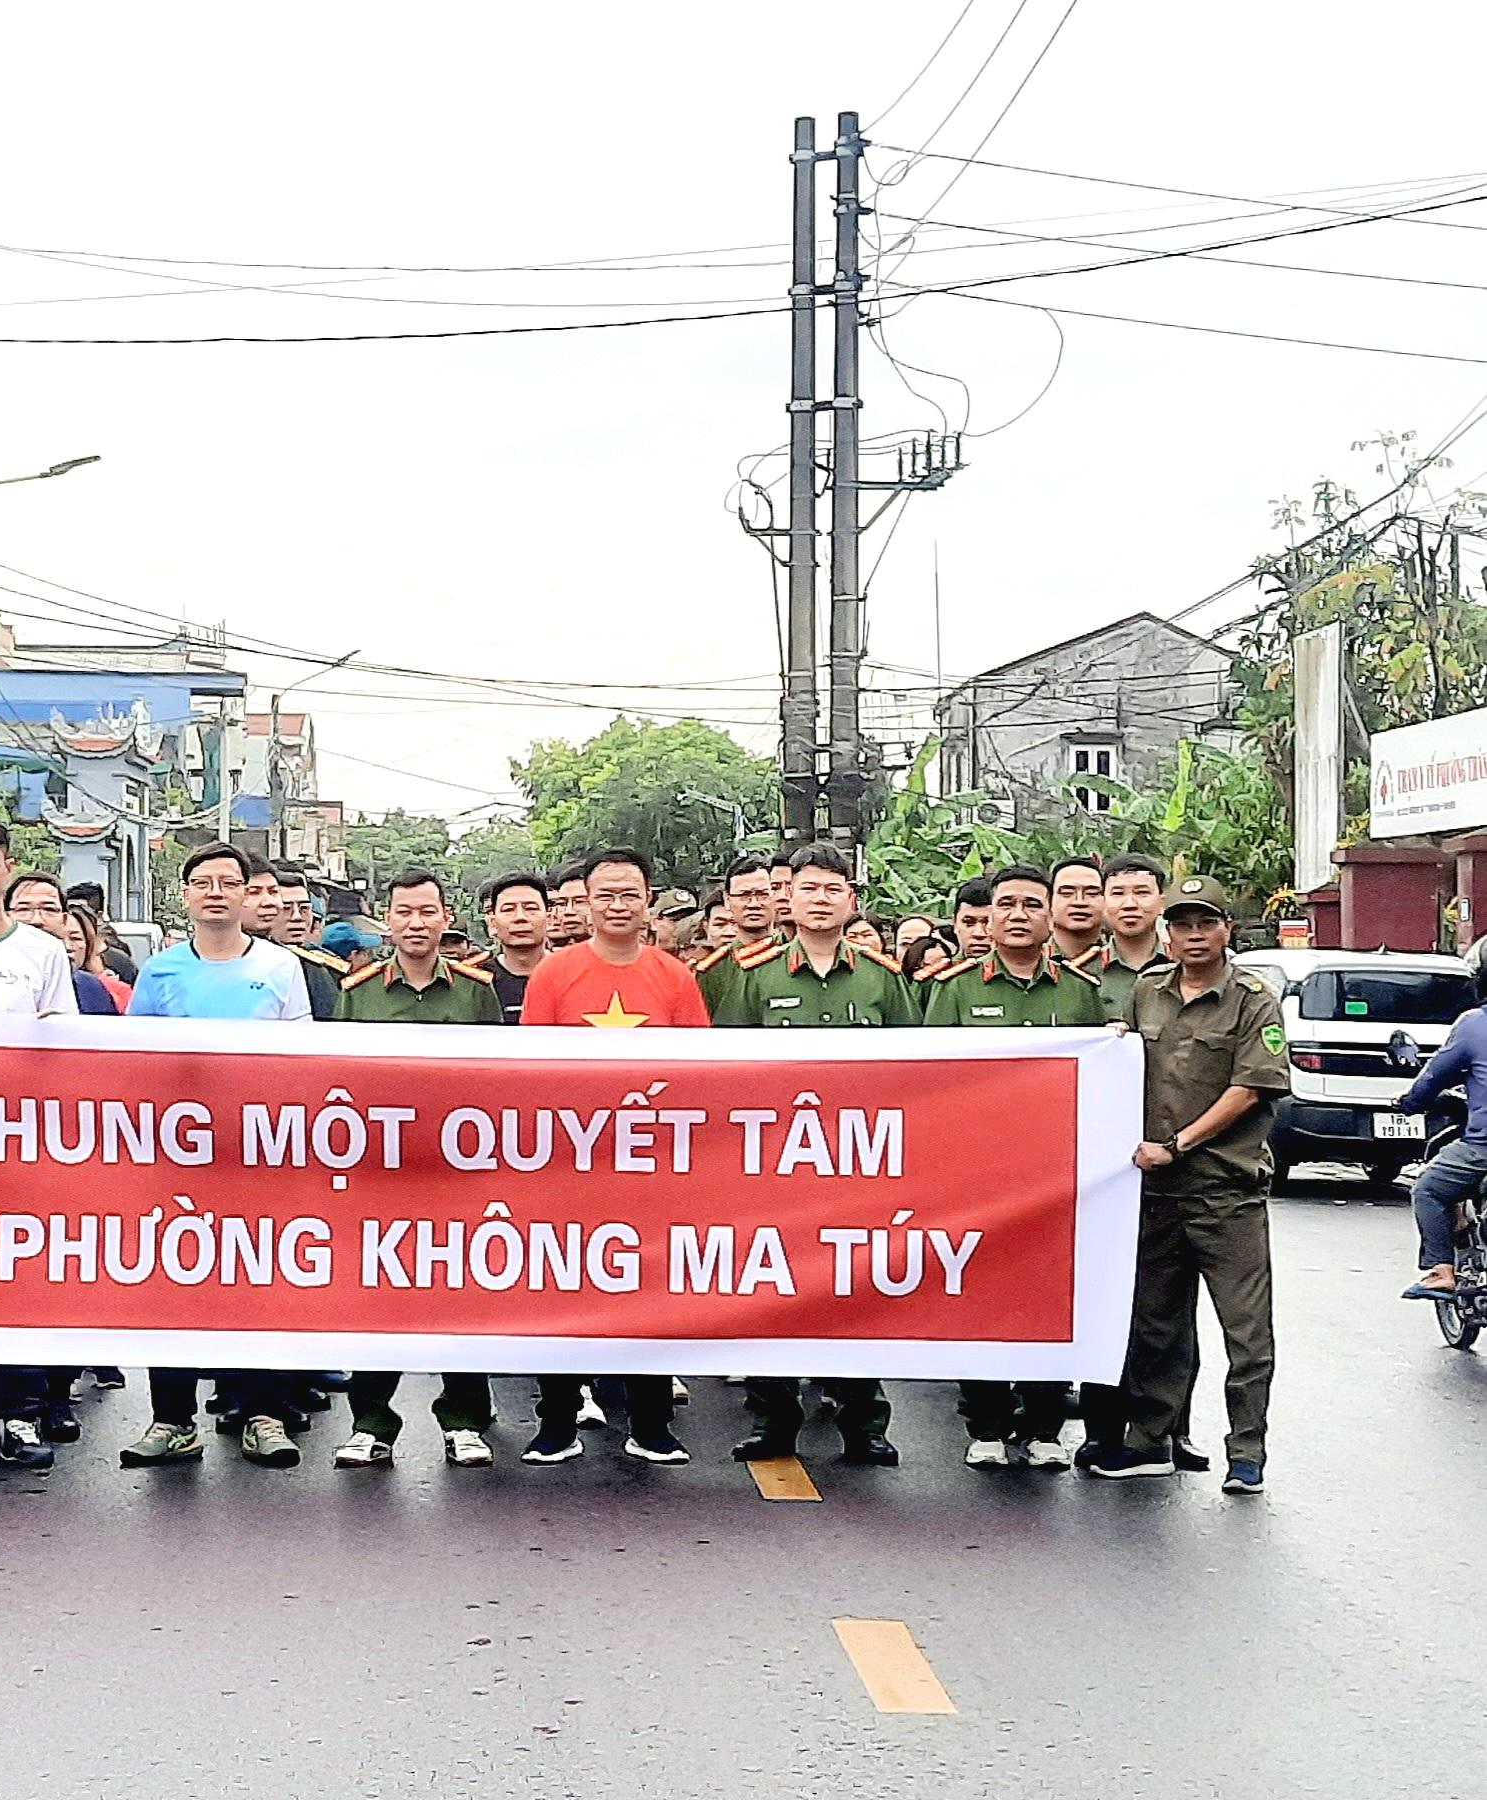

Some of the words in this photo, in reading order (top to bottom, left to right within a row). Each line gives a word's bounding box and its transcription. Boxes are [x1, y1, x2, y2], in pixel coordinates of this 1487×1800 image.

[243, 1087, 416, 1190] MỘT
[442, 1081, 707, 1173] QUYẾT
[730, 1091, 903, 1177] TÂM
[363, 1201, 640, 1293] KHÔNG
[670, 1226, 797, 1296] MA
[820, 1209, 983, 1296] TÚY
